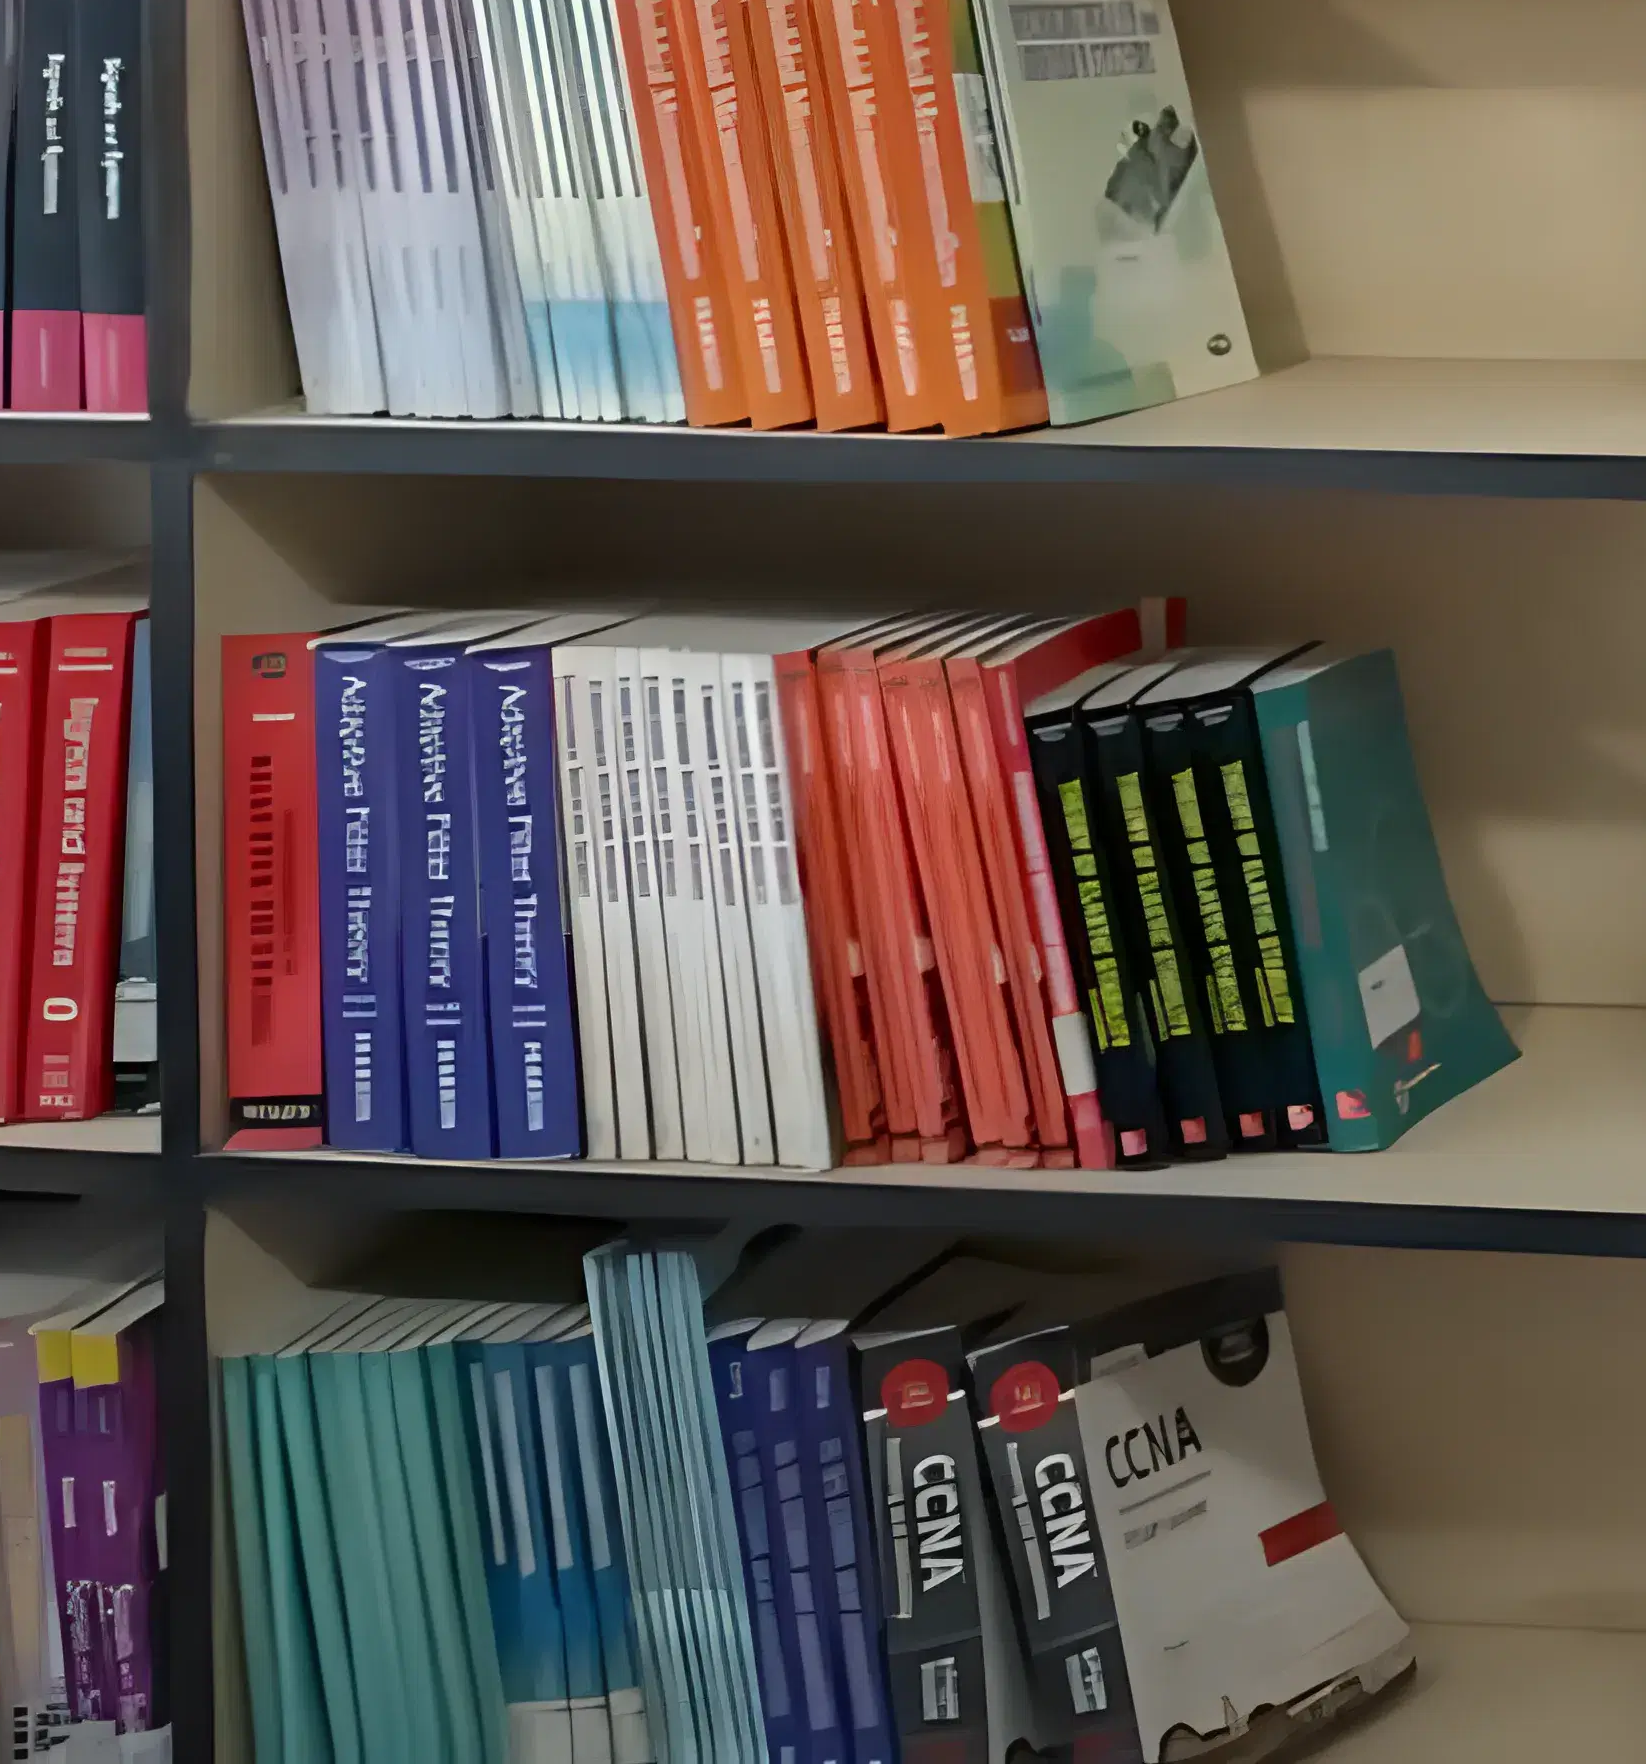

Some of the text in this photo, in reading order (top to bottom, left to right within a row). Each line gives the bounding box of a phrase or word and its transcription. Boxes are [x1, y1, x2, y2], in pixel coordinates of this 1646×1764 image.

[1105, 1406, 1202, 1488] CCNA
[913, 1454, 964, 1592] CCNA
[1035, 1453, 1096, 1589] CCNA
